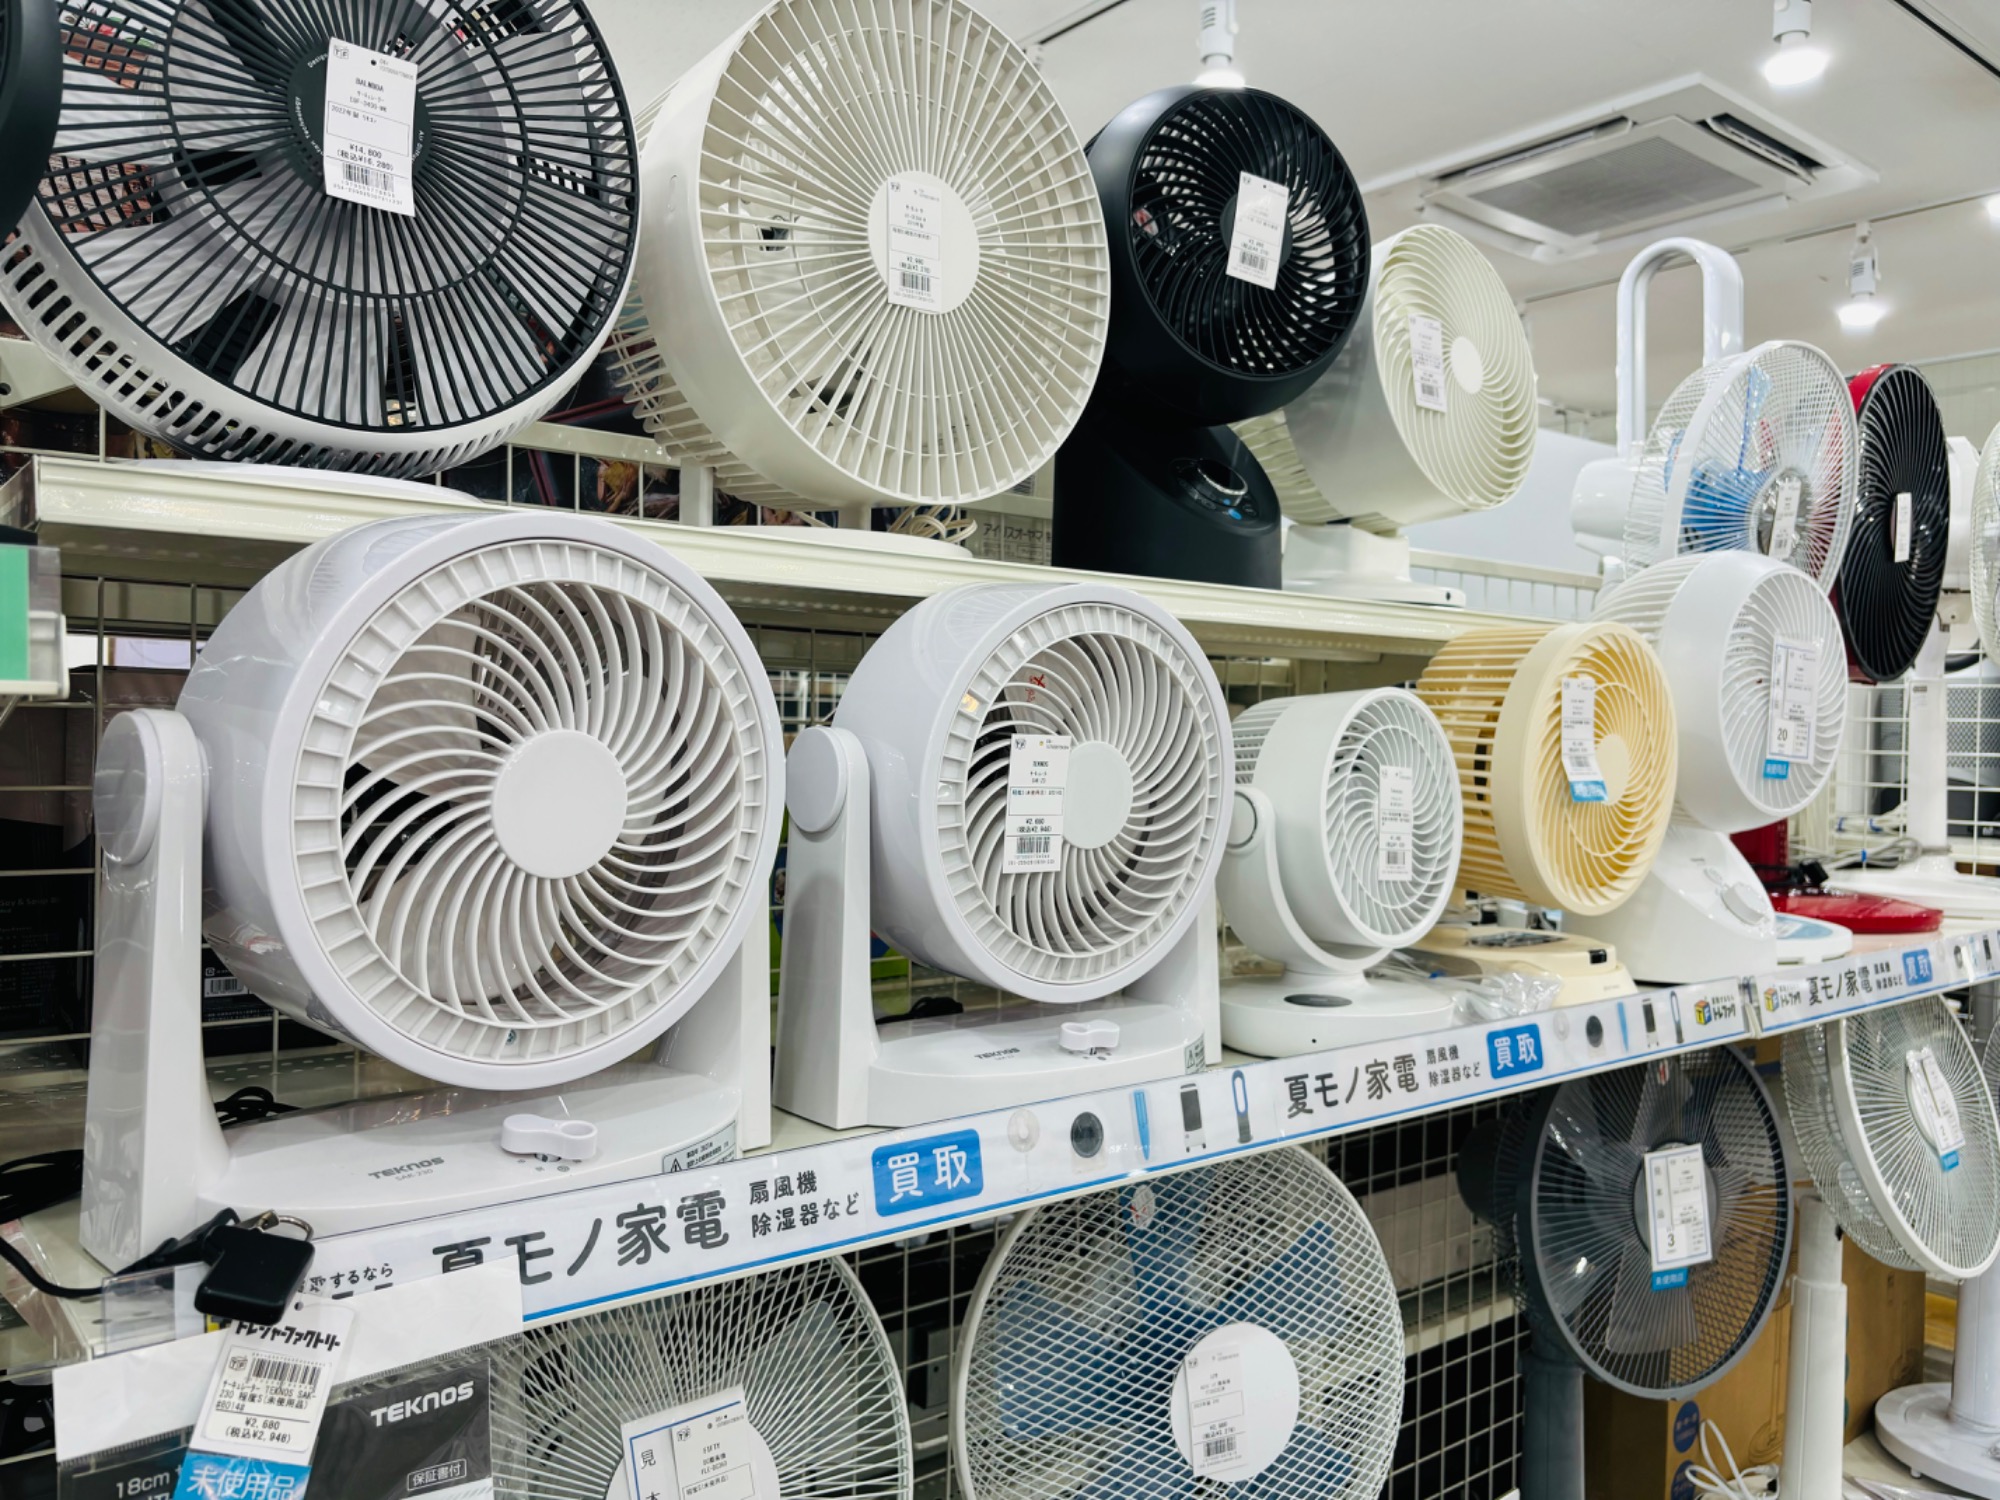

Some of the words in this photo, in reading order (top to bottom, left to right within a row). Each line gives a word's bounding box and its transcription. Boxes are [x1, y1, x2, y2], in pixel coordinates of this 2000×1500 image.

[1777, 728, 1788, 741] 20
[1806, 966, 1873, 1006] 夏モノ家電
[1426, 1045, 1460, 1065] 扇風機
[1494, 1033, 1539, 1071] 買取
[1284, 1053, 1420, 1119] 夏モノ家電
[368, 1156, 445, 1180] TEKNOS
[889, 1144, 971, 1203] 買取
[749, 1170, 818, 1205] 扇風機
[752, 1191, 860, 1238] 除湿器など
[1668, 1233, 1675, 1248] 3
[265, 1386, 294, 1397] TEKNOS
[371, 1381, 474, 1427] TEKNOS
[116, 1472, 170, 1499] 18cm
[186, 1465, 296, 1500] 未使用品
[412, 1463, 461, 1487] 保証書付
